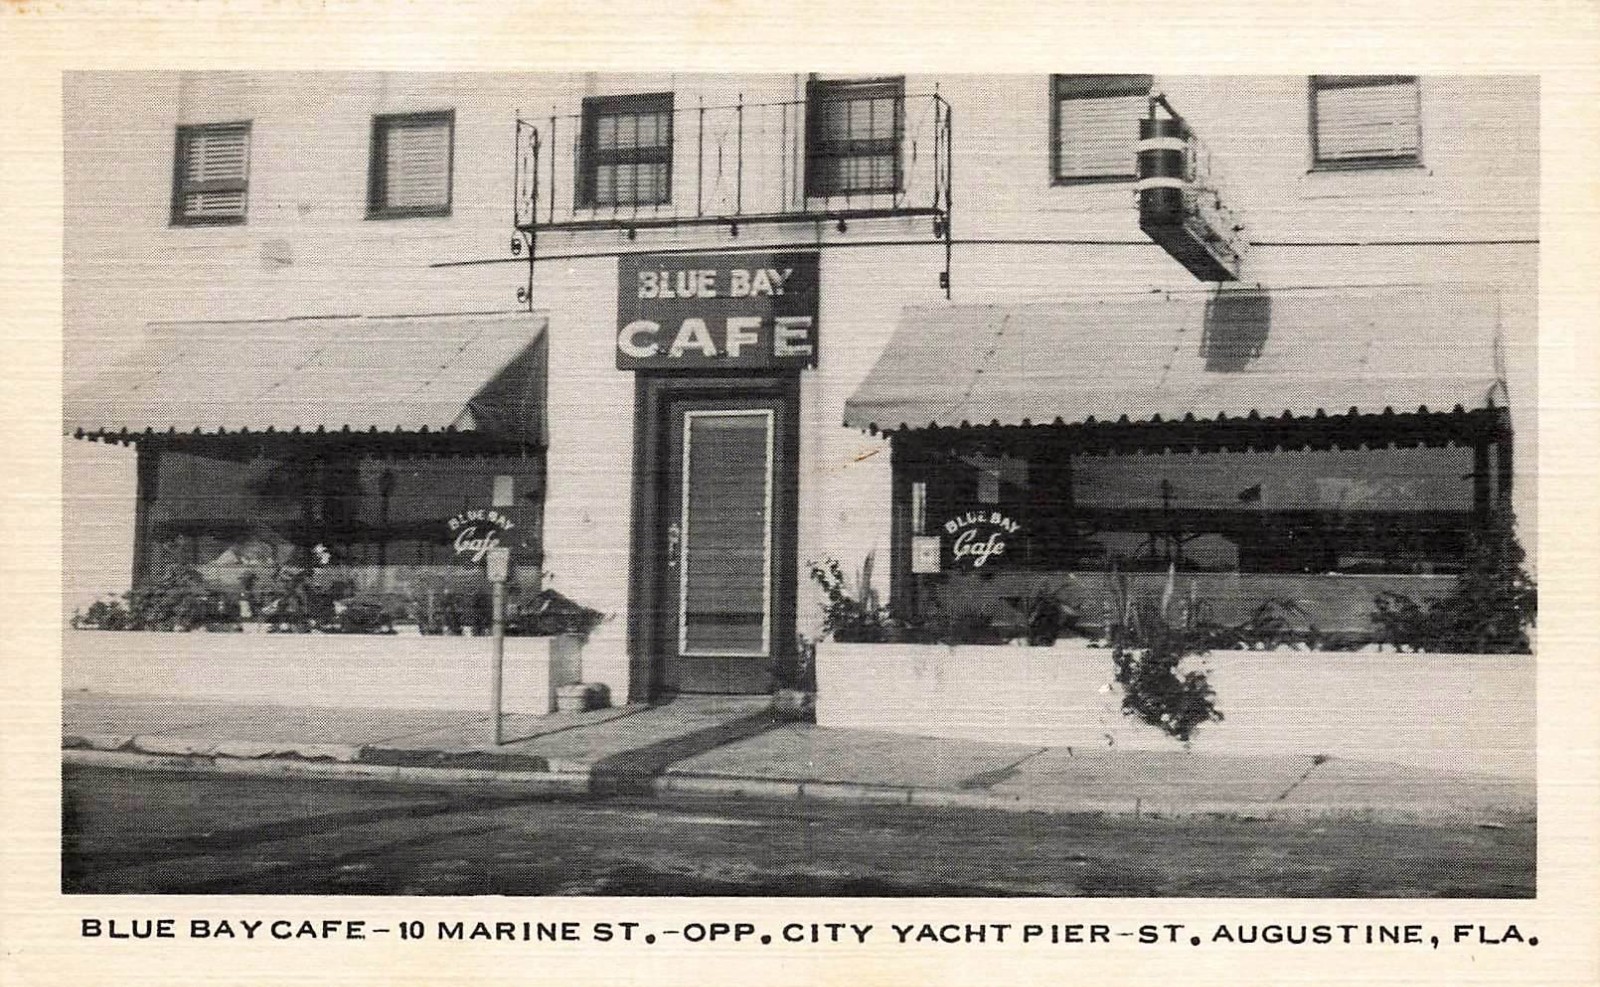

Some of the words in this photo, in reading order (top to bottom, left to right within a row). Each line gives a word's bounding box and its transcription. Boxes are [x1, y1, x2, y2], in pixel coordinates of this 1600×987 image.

[637, 269, 717, 298] BLUE
[730, 268, 793, 297] BAY
[617, 316, 812, 358] CAFE
[448, 509, 485, 531] BLUE
[488, 511, 515, 531] BAY
[944, 510, 987, 534] BLUE
[989, 511, 1021, 533] BAY
[453, 526, 500, 562] Cafe
[953, 529, 1005, 568] Cafe
